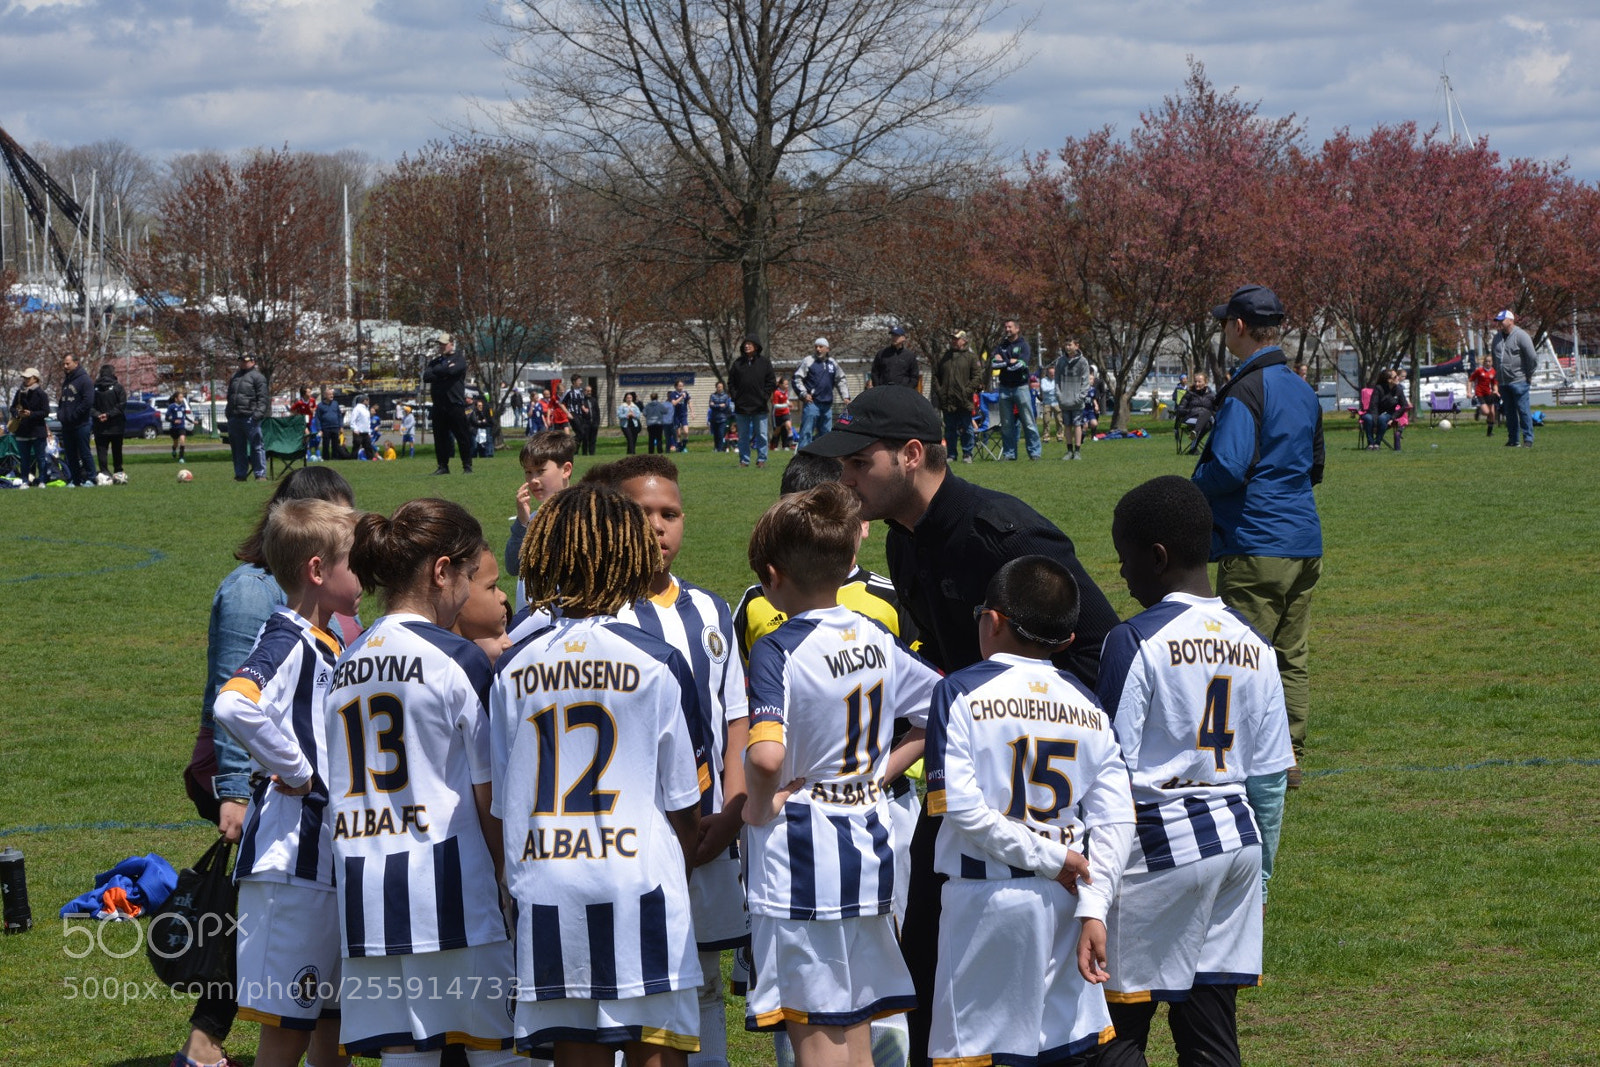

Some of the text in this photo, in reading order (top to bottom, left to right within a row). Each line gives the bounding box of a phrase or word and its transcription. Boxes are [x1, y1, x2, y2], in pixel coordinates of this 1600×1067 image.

[823, 644, 887, 679] WILSON
[1167, 638, 1260, 671] BOTCHWAY
[511, 659, 640, 699] TOWNSEND
[834, 678, 884, 777] 11
[1196, 674, 1235, 772] 4
[338, 692, 409, 798] 13
[527, 700, 621, 817] 12
[811, 781, 866, 806] ALBA
[1002, 734, 1079, 824] 15
[333, 804, 429, 841] ALBA FC
[520, 826, 638, 863] ALBA FC
